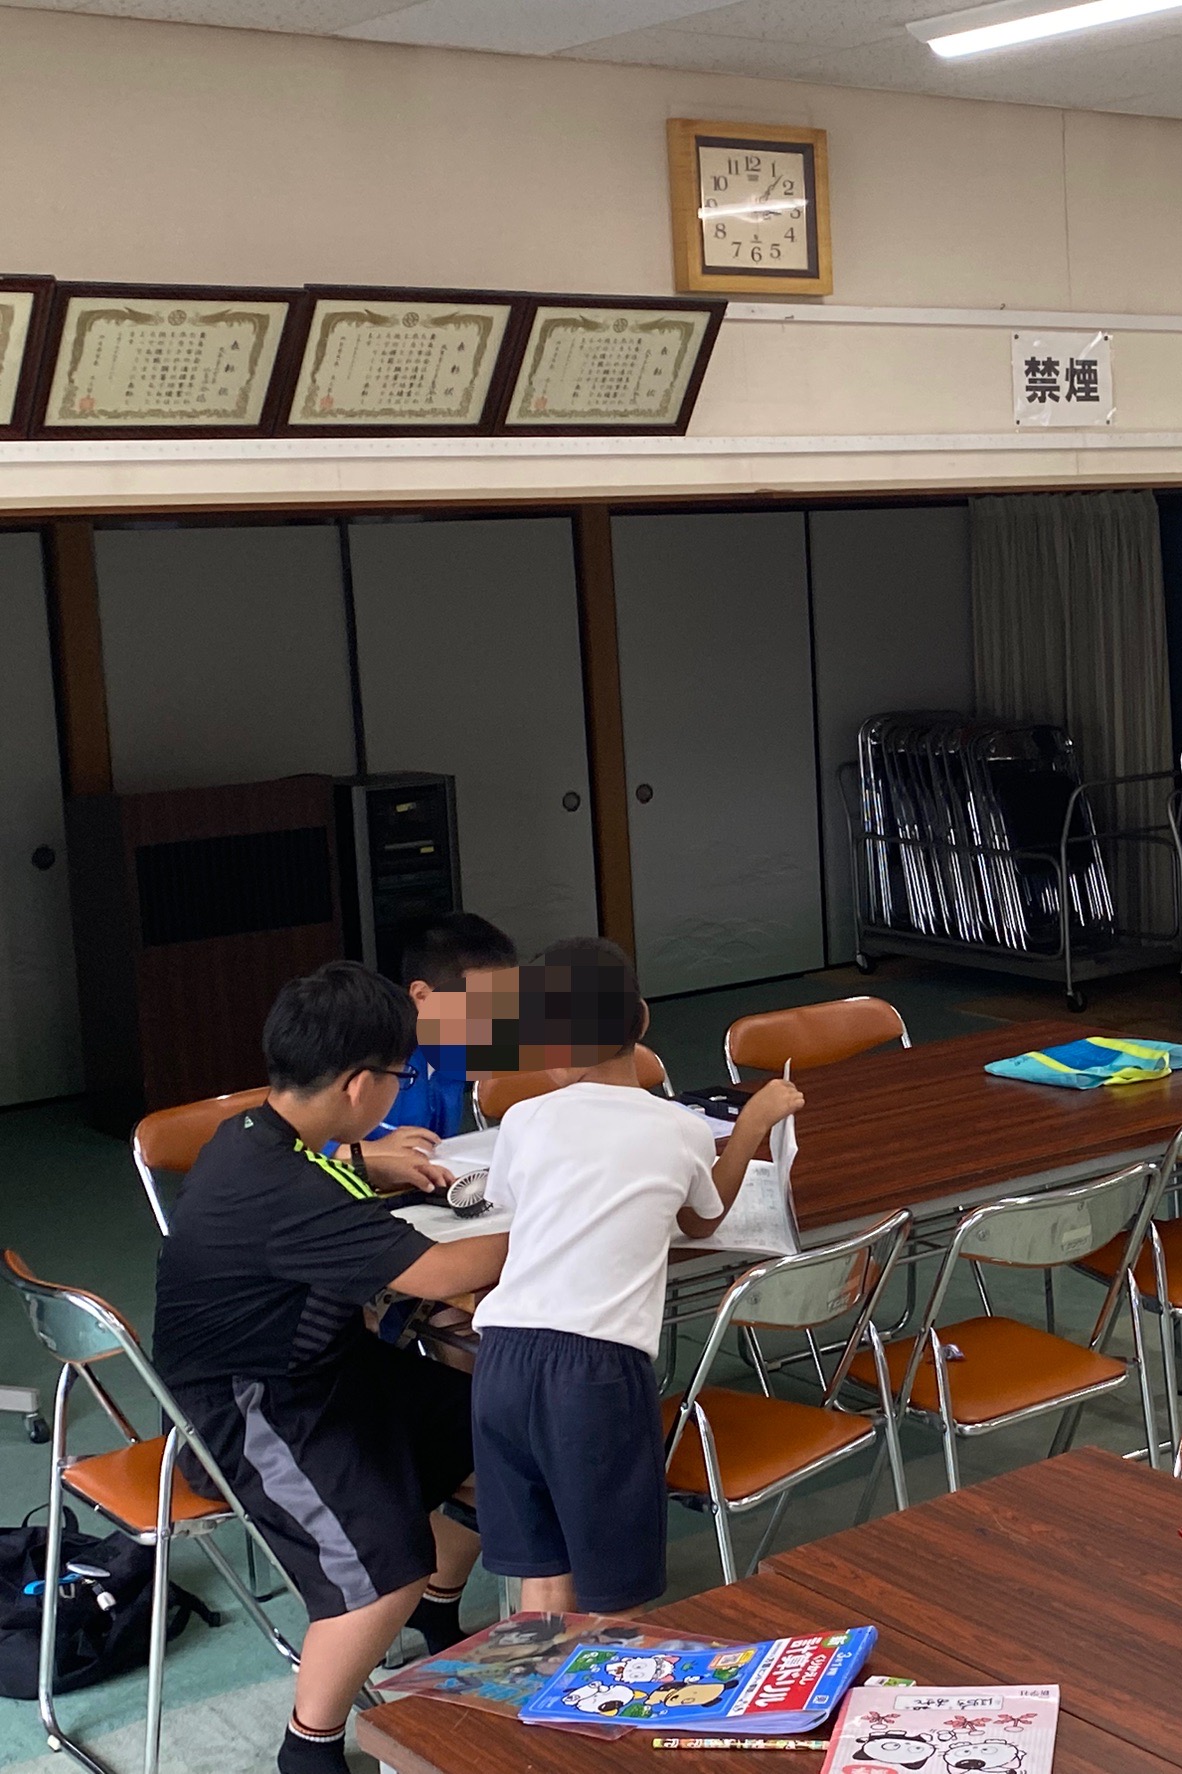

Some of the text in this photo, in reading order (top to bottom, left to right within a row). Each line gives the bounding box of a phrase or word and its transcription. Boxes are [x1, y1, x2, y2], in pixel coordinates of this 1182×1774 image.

[728, 157, 739, 175] 11
[744, 156, 760, 172] 12
[771, 160, 777, 177] 1
[712, 176, 728, 191] 10
[782, 180, 794, 195] 2
[714, 223, 727, 239] 8
[784, 227, 795, 242] 4
[731, 242, 742, 258] 7
[751, 247, 762, 262] 6
[770, 244, 781, 259] 5
[1024, 357, 1100, 403] 禁煙
[755, 1637, 823, 1707] 計算ドリル
